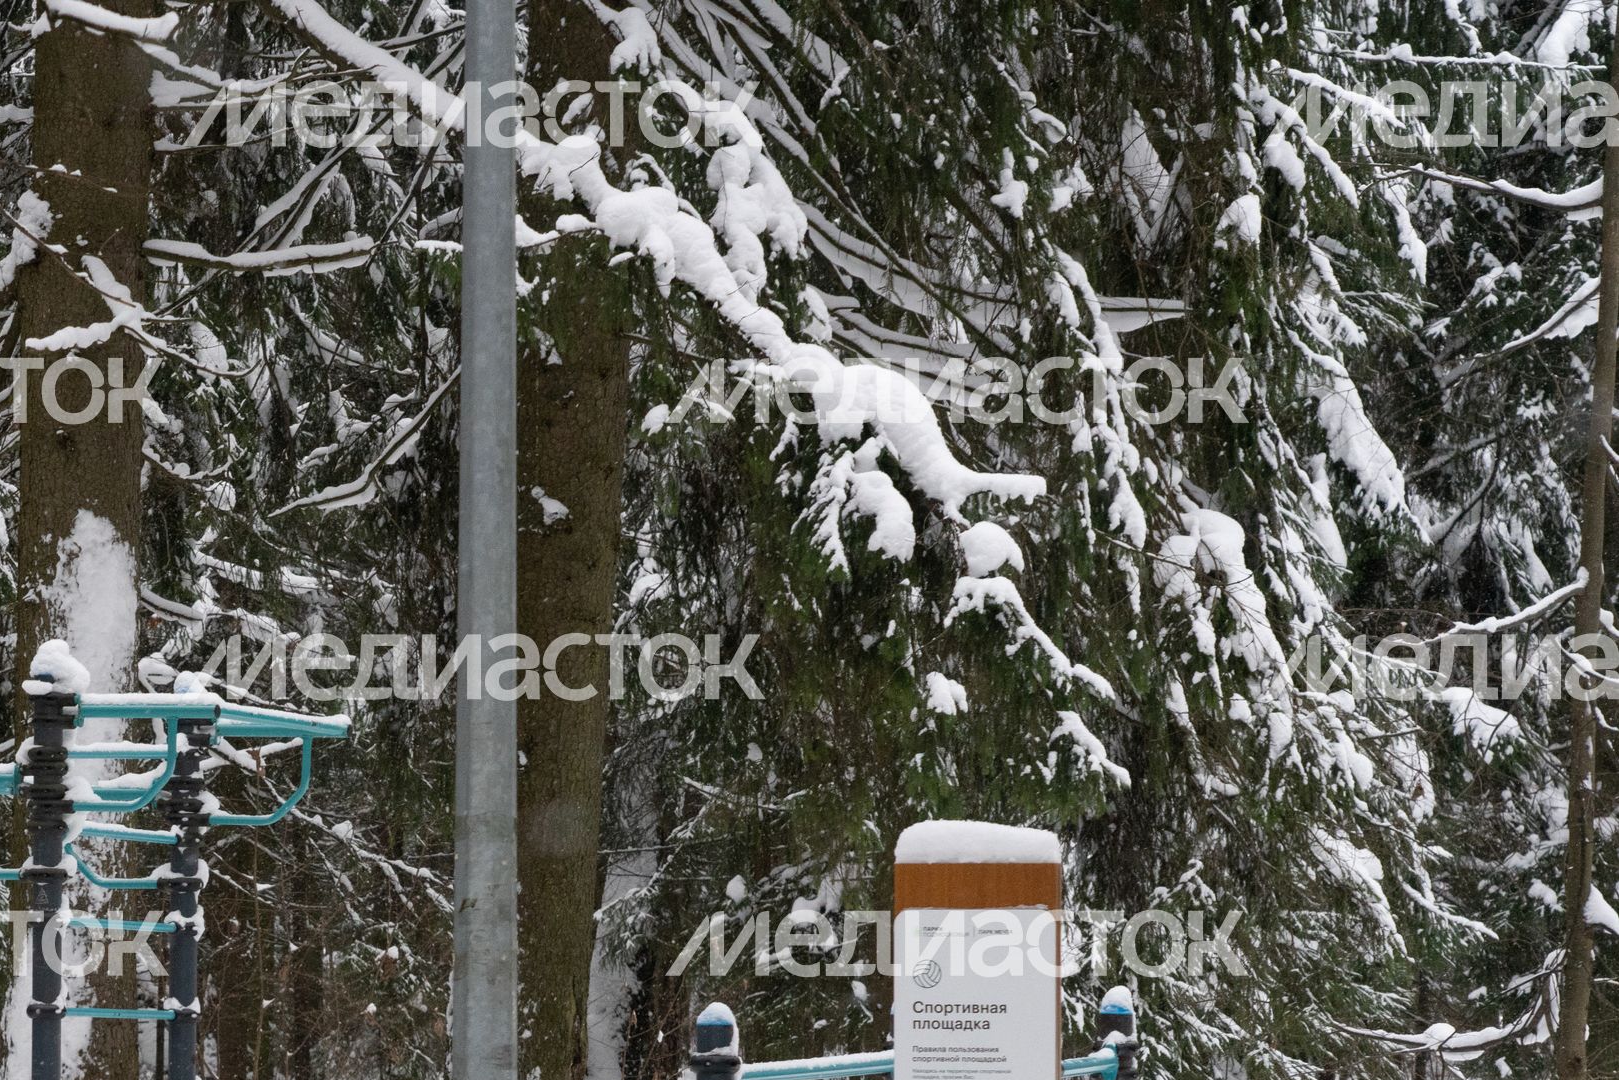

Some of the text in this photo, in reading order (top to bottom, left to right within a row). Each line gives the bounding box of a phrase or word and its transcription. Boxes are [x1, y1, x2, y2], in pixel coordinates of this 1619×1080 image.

[912, 1001, 1007, 1016] Спортивная
[912, 1019, 991, 1031] площадка
[912, 1046, 947, 1054] Правила
[912, 1055, 1007, 1063] спортивной площадкой
